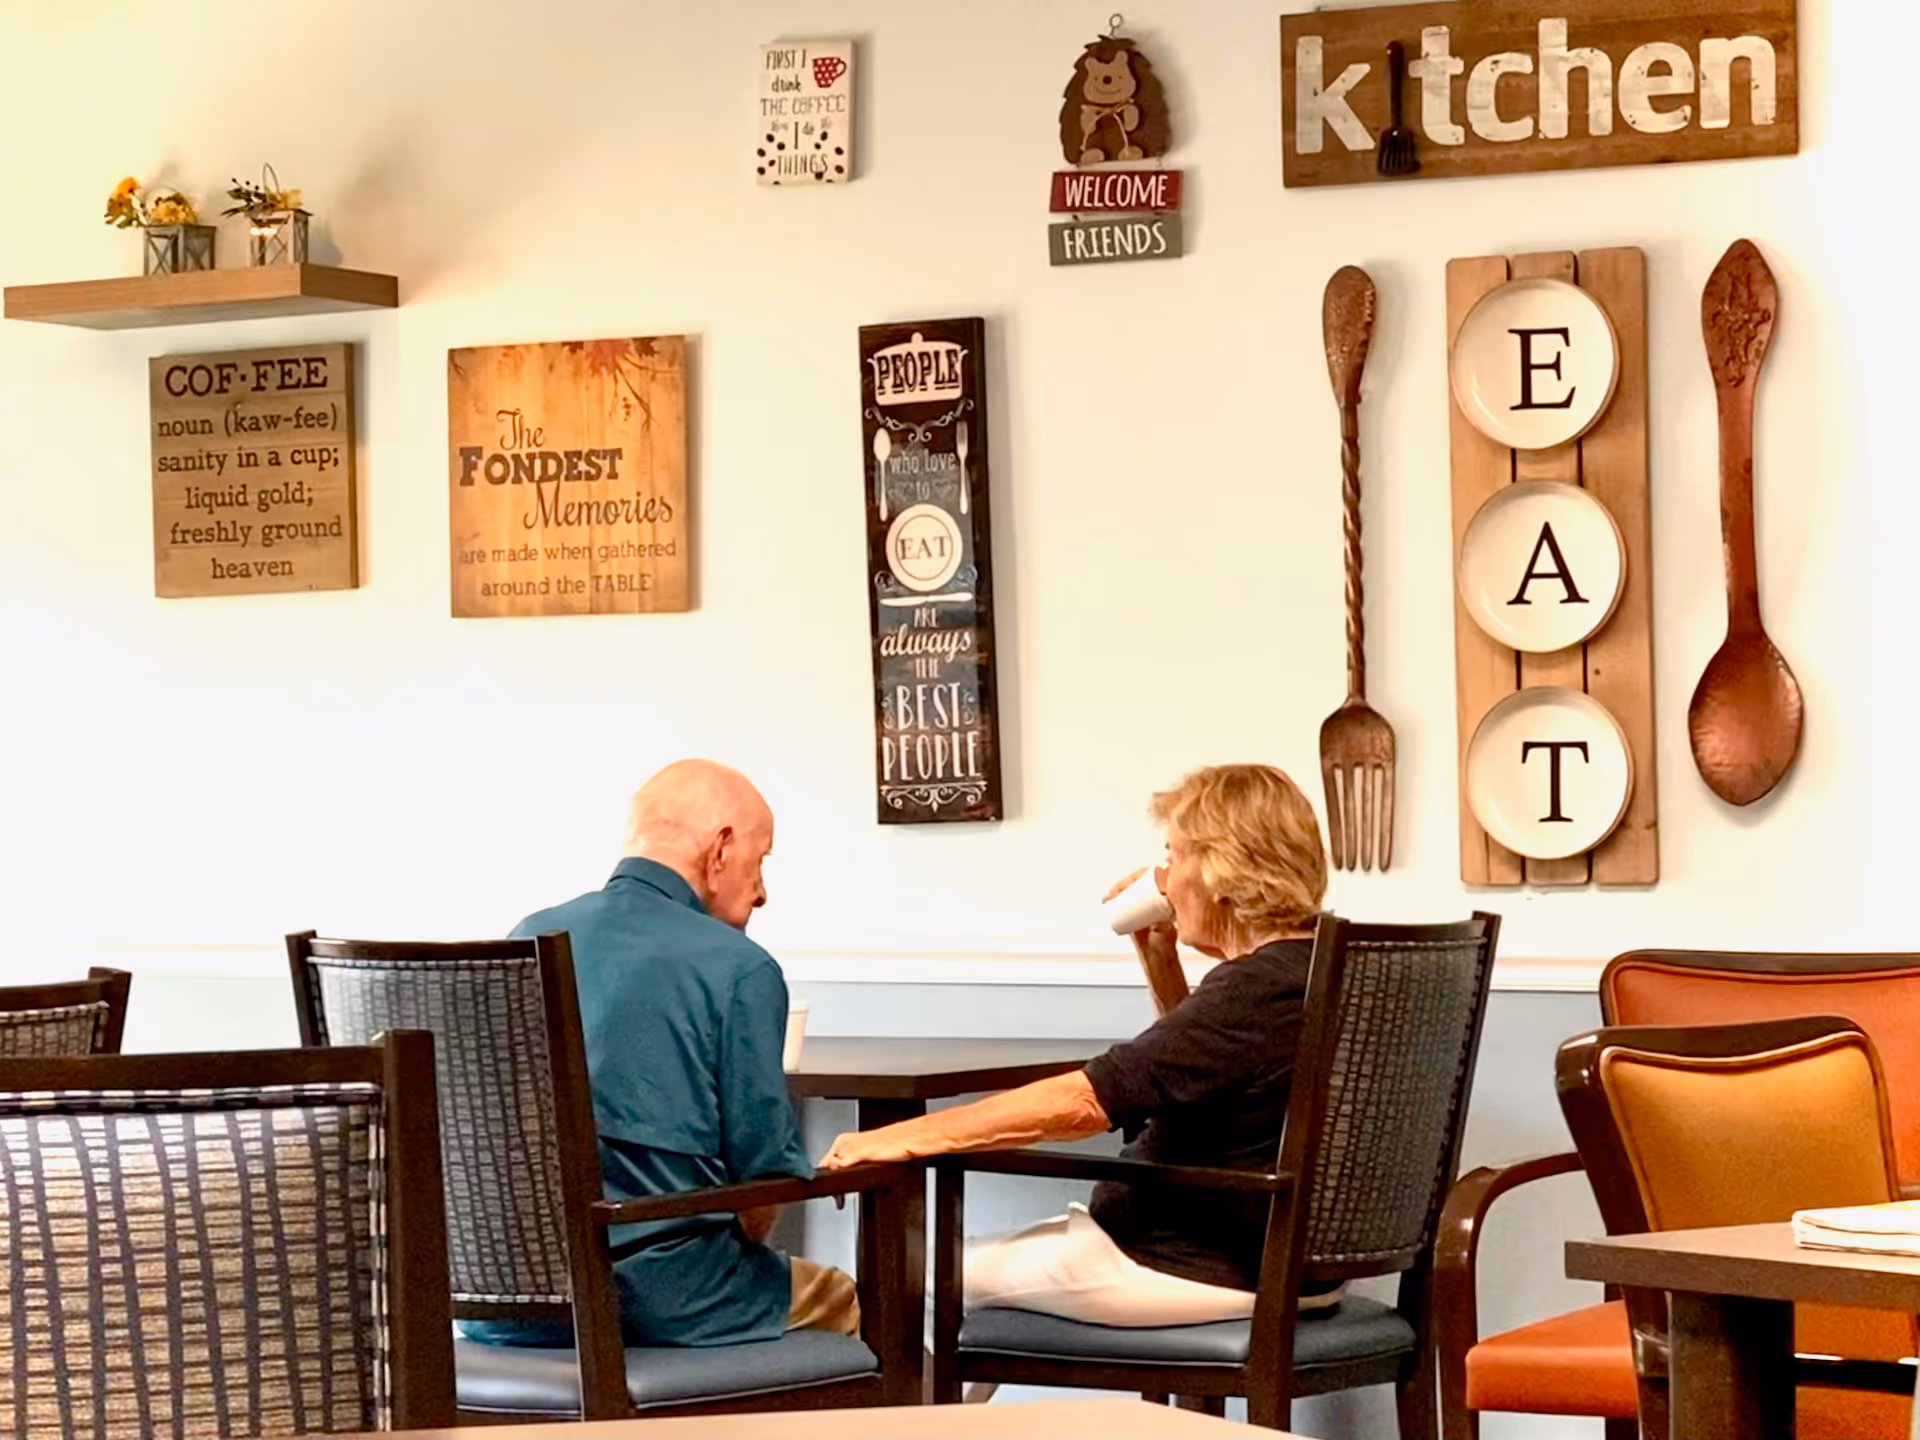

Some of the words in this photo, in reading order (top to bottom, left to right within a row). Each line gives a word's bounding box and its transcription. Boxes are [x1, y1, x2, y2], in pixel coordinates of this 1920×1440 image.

[766, 50, 796, 70] FIRST
[802, 49, 806, 68] I
[760, 98, 787, 116] THE
[792, 94, 846, 115] COFFEE
[777, 153, 828, 175] THINGS
[1064, 175, 1168, 208] WELCOME
[1063, 222, 1166, 259] FRIENDS
[877, 349, 960, 394] PEOPLE
[158, 418, 214, 437] noun
[224, 403, 337, 437] (kaw-fee)
[496, 408, 546, 450] The
[158, 450, 227, 476] sanity
[237, 446, 258, 467] in
[268, 451, 281, 466] a
[290, 447, 338, 471] cup;
[459, 446, 623, 487] FONDEST
[890, 450, 920, 475] who
[925, 449, 956, 473] love
[185, 484, 249, 514] liquid
[257, 481, 313, 512] gold;
[523, 480, 673, 529] Memories
[916, 481, 930, 500] to
[170, 521, 252, 547] freshly
[261, 515, 342, 547] ground
[459, 549, 487, 565] are
[492, 544, 538, 563] made
[545, 542, 592, 561] when
[598, 538, 676, 563] gathered
[899, 536, 949, 561] EAT
[211, 558, 294, 579] heaven
[481, 577, 550, 597] around
[556, 576, 586, 595] the
[591, 573, 651, 593] TABLE
[914, 607, 938, 628] ARE
[880, 624, 971, 663] always
[915, 658, 939, 679] THE
[896, 683, 961, 731] BEST
[882, 731, 982, 781] PEOPLE
